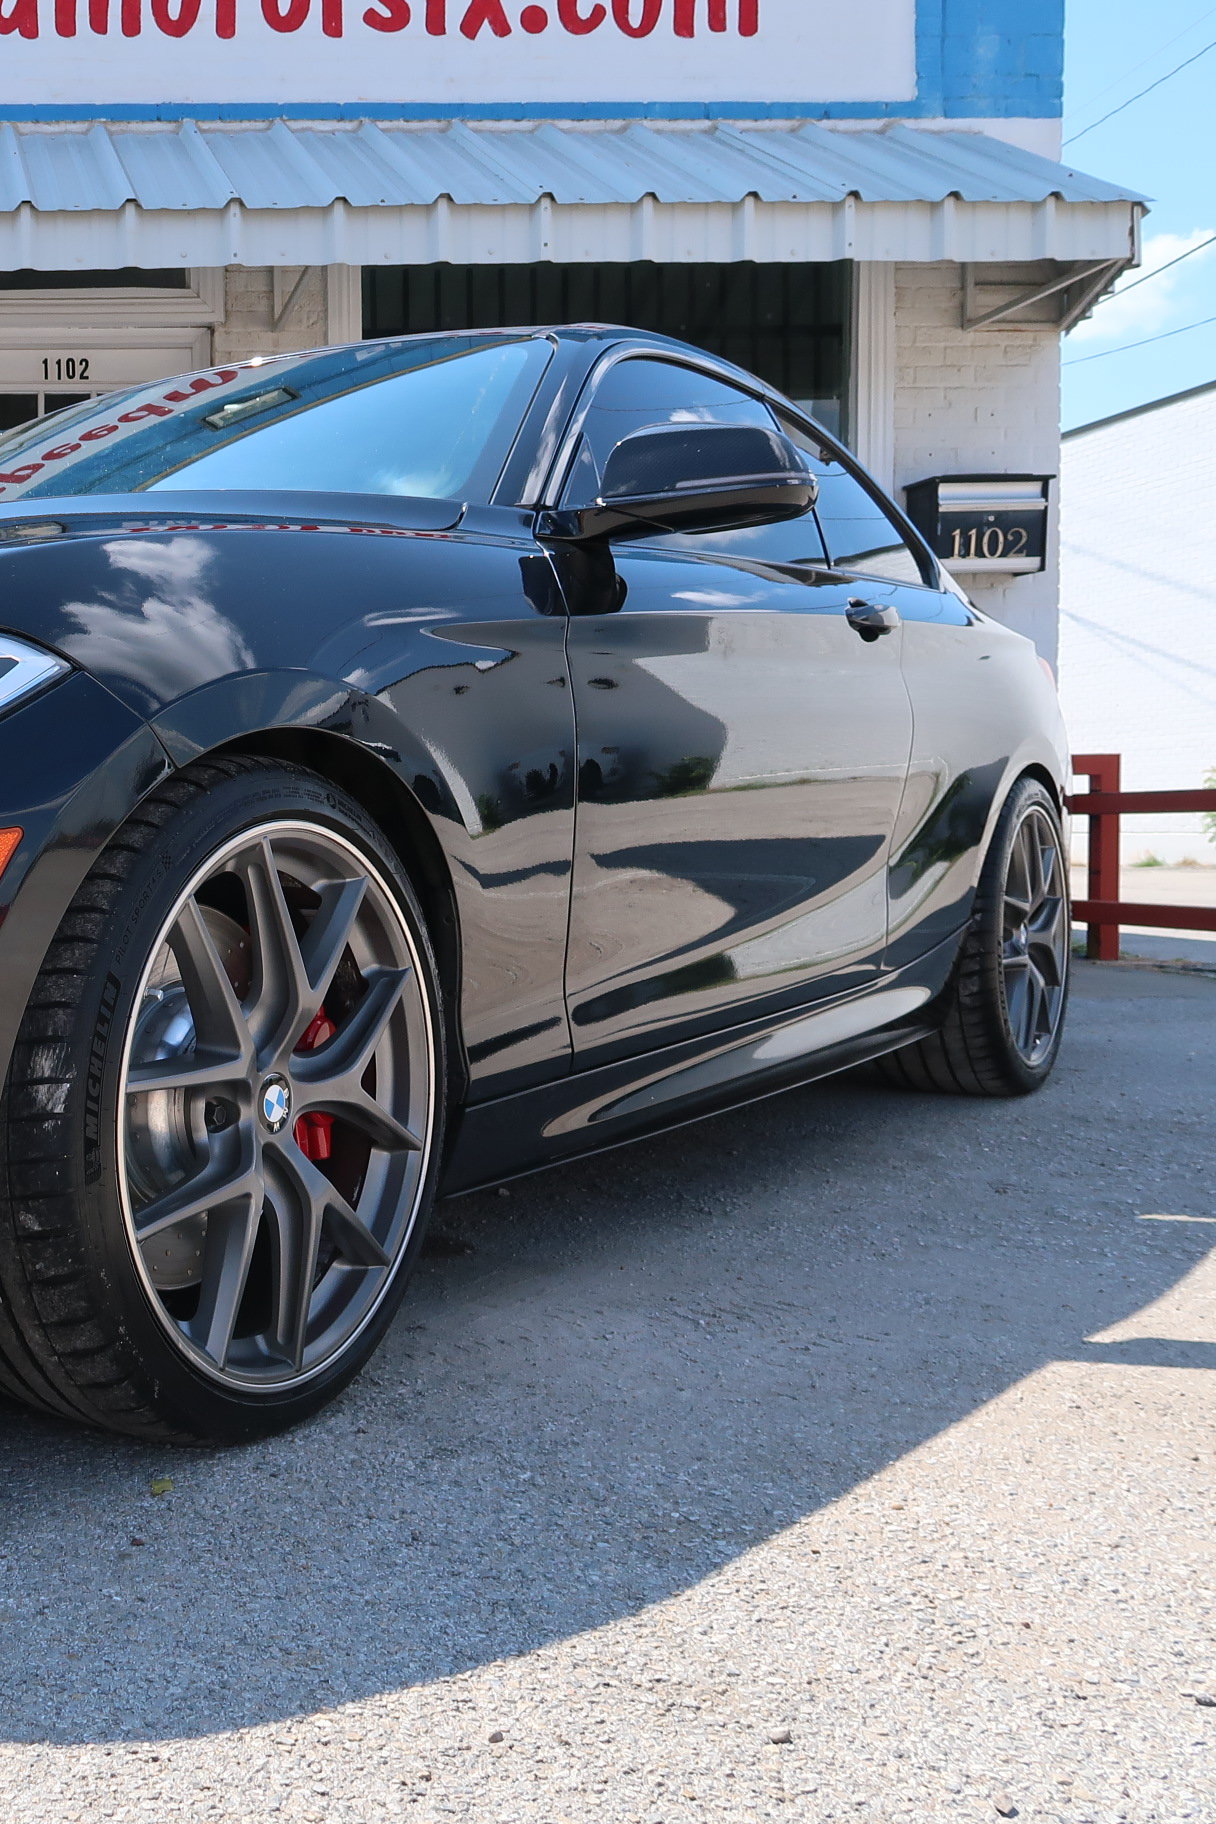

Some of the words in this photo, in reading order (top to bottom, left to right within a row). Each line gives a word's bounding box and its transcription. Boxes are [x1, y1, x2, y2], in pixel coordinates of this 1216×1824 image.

[41, 357, 90, 381] 1102
[949, 527, 1029, 559] 1102
[85, 979, 119, 1142] MICHELIN
